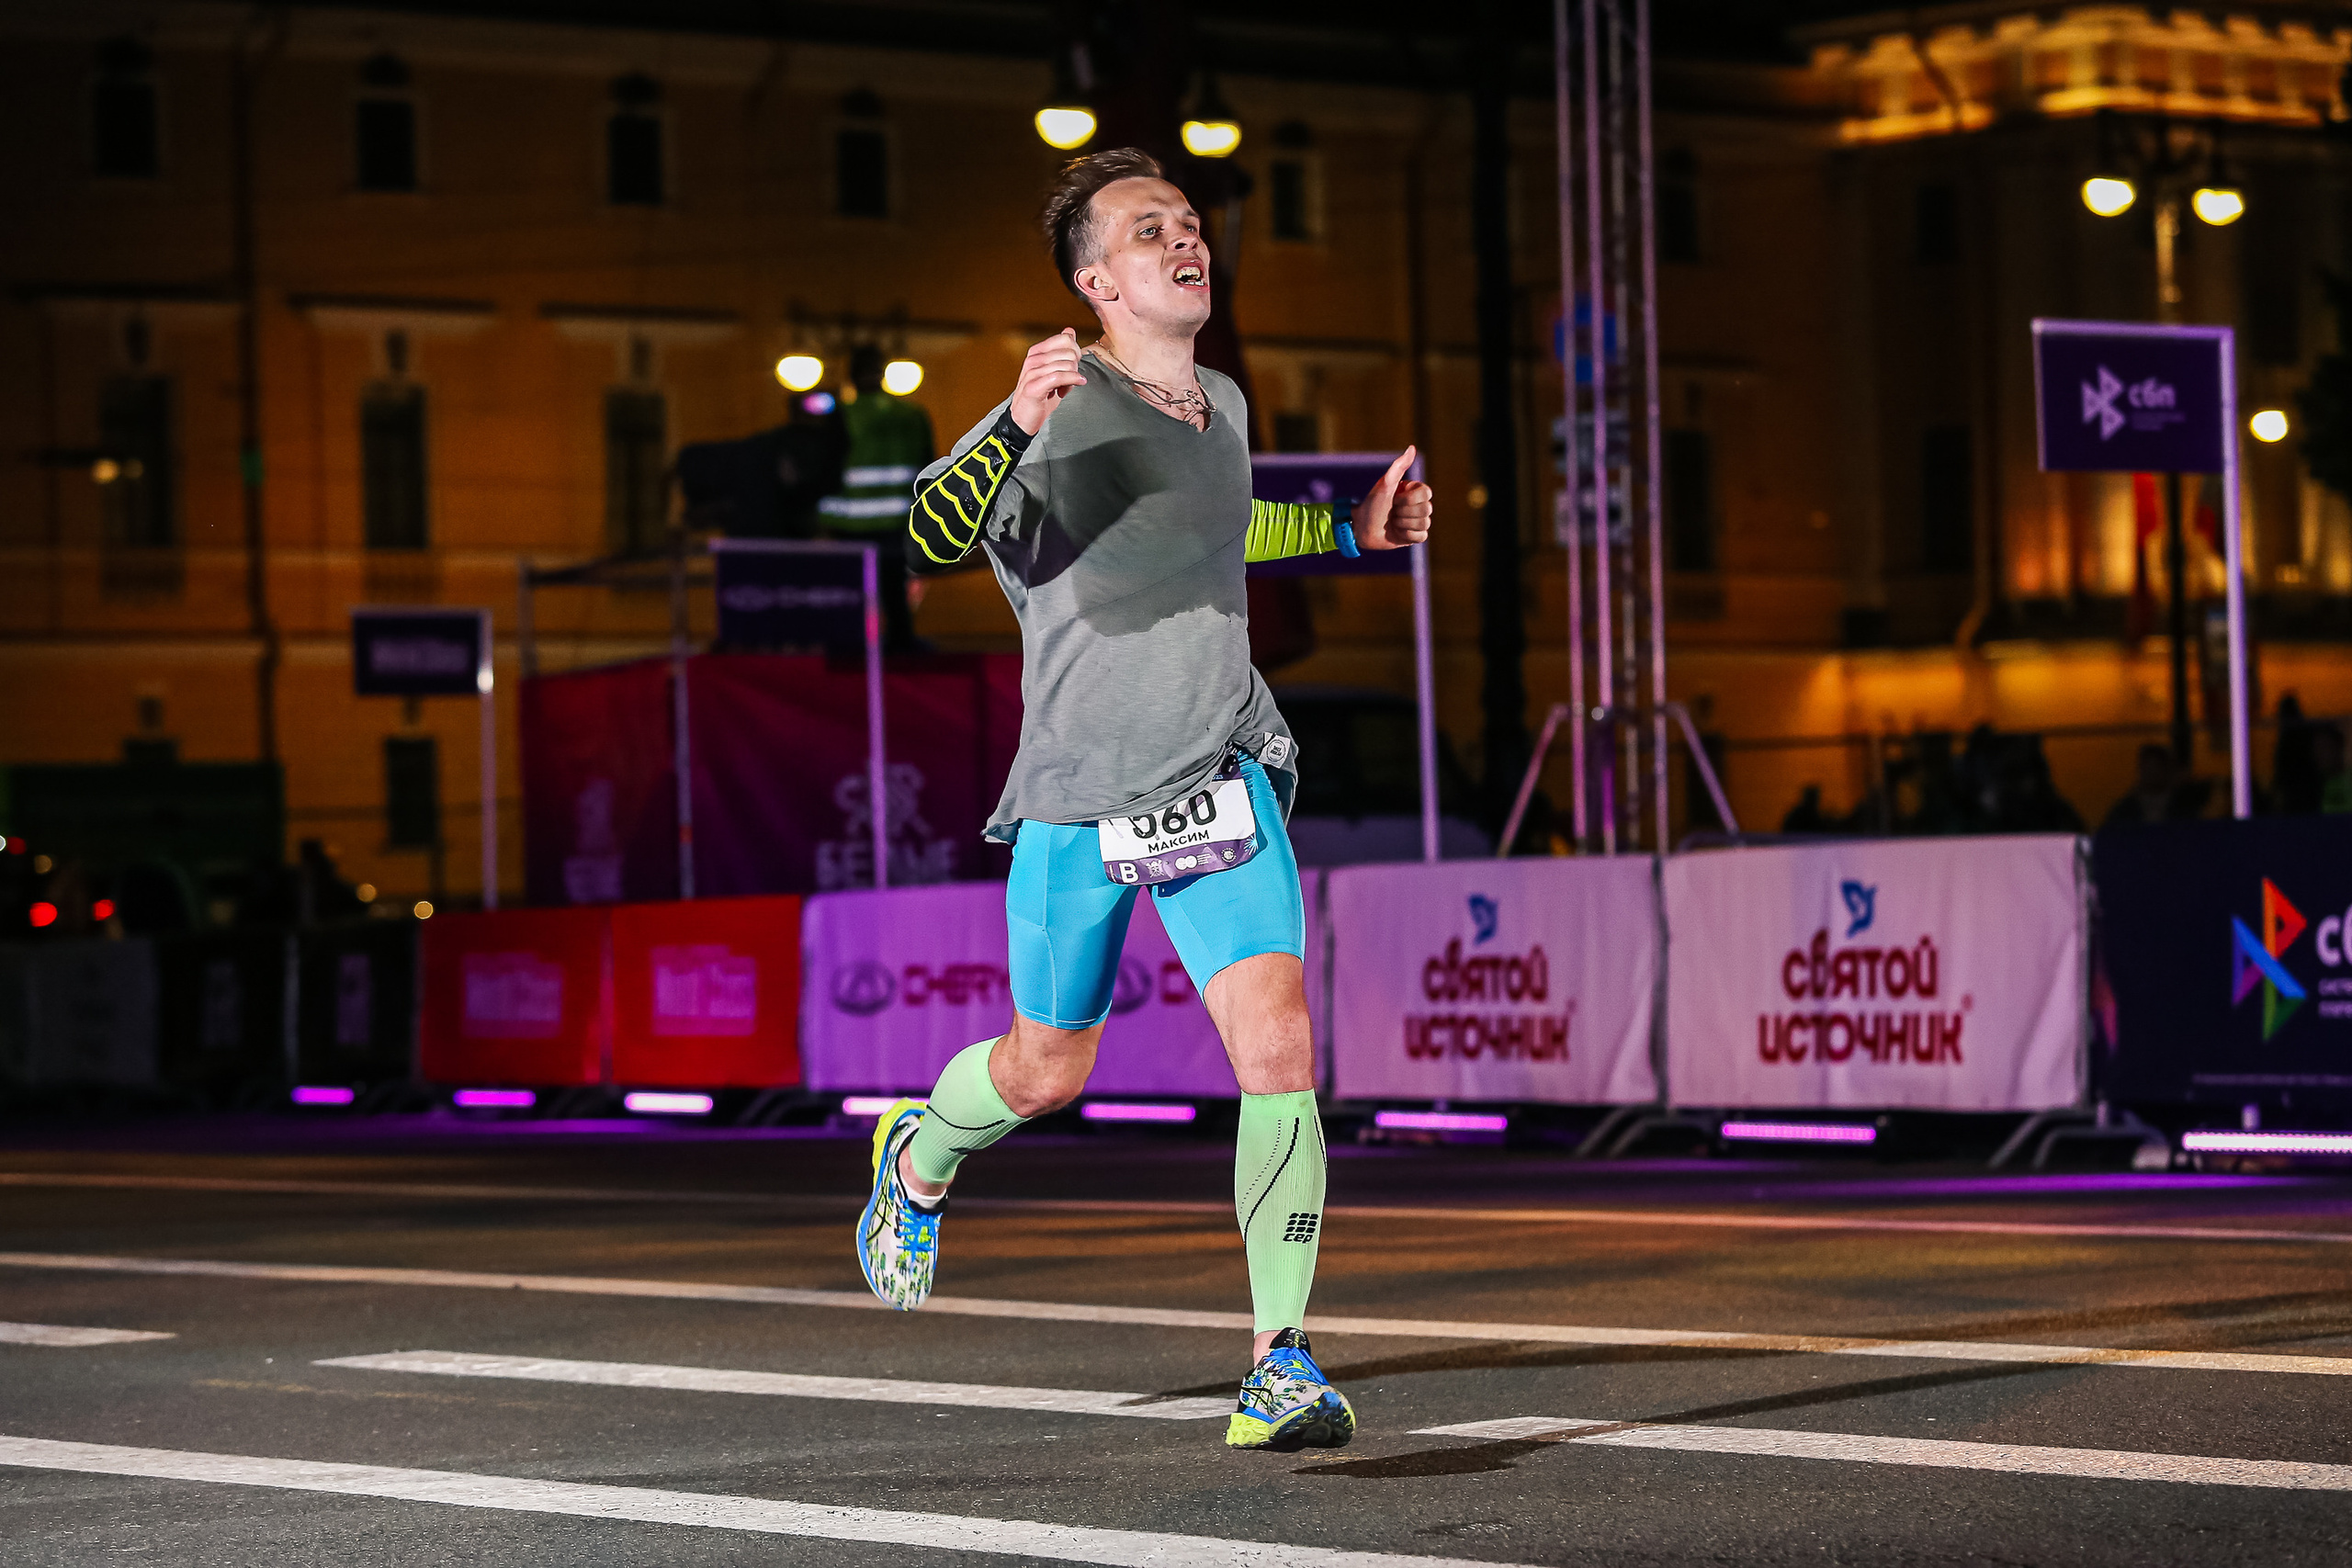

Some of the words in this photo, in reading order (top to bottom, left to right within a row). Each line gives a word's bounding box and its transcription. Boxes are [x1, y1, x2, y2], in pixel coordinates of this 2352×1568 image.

[1132, 789, 1216, 840] 560
[1148, 829, 1210, 854] МАКСИМ
[1283, 1233, 1313, 1244] cep
